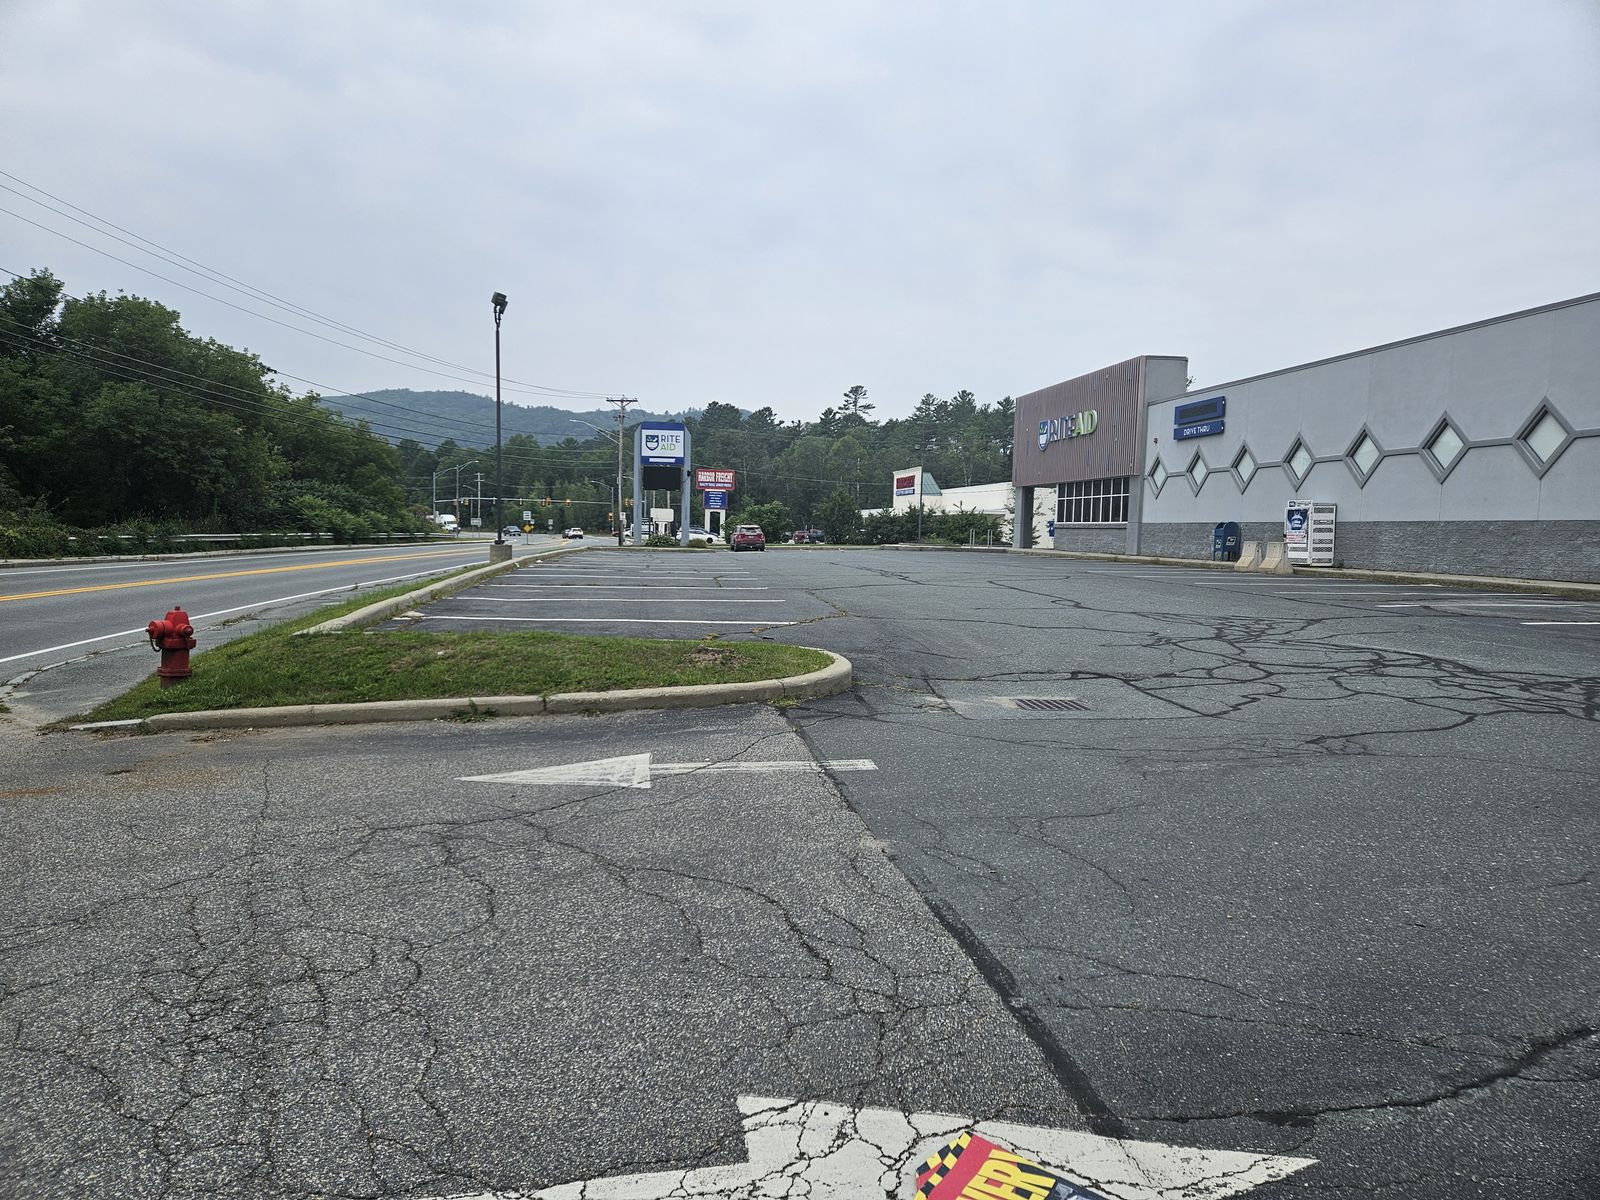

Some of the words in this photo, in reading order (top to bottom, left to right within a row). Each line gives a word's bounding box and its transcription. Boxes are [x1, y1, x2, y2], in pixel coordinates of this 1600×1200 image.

[1050, 415, 1076, 441] RITE
[1074, 410, 1098, 436] AID
[1184, 427, 1197, 436] DRIVE
[1197, 425, 1211, 434] THRU
[661, 435, 681, 443] RITE
[660, 443, 676, 451] AID
